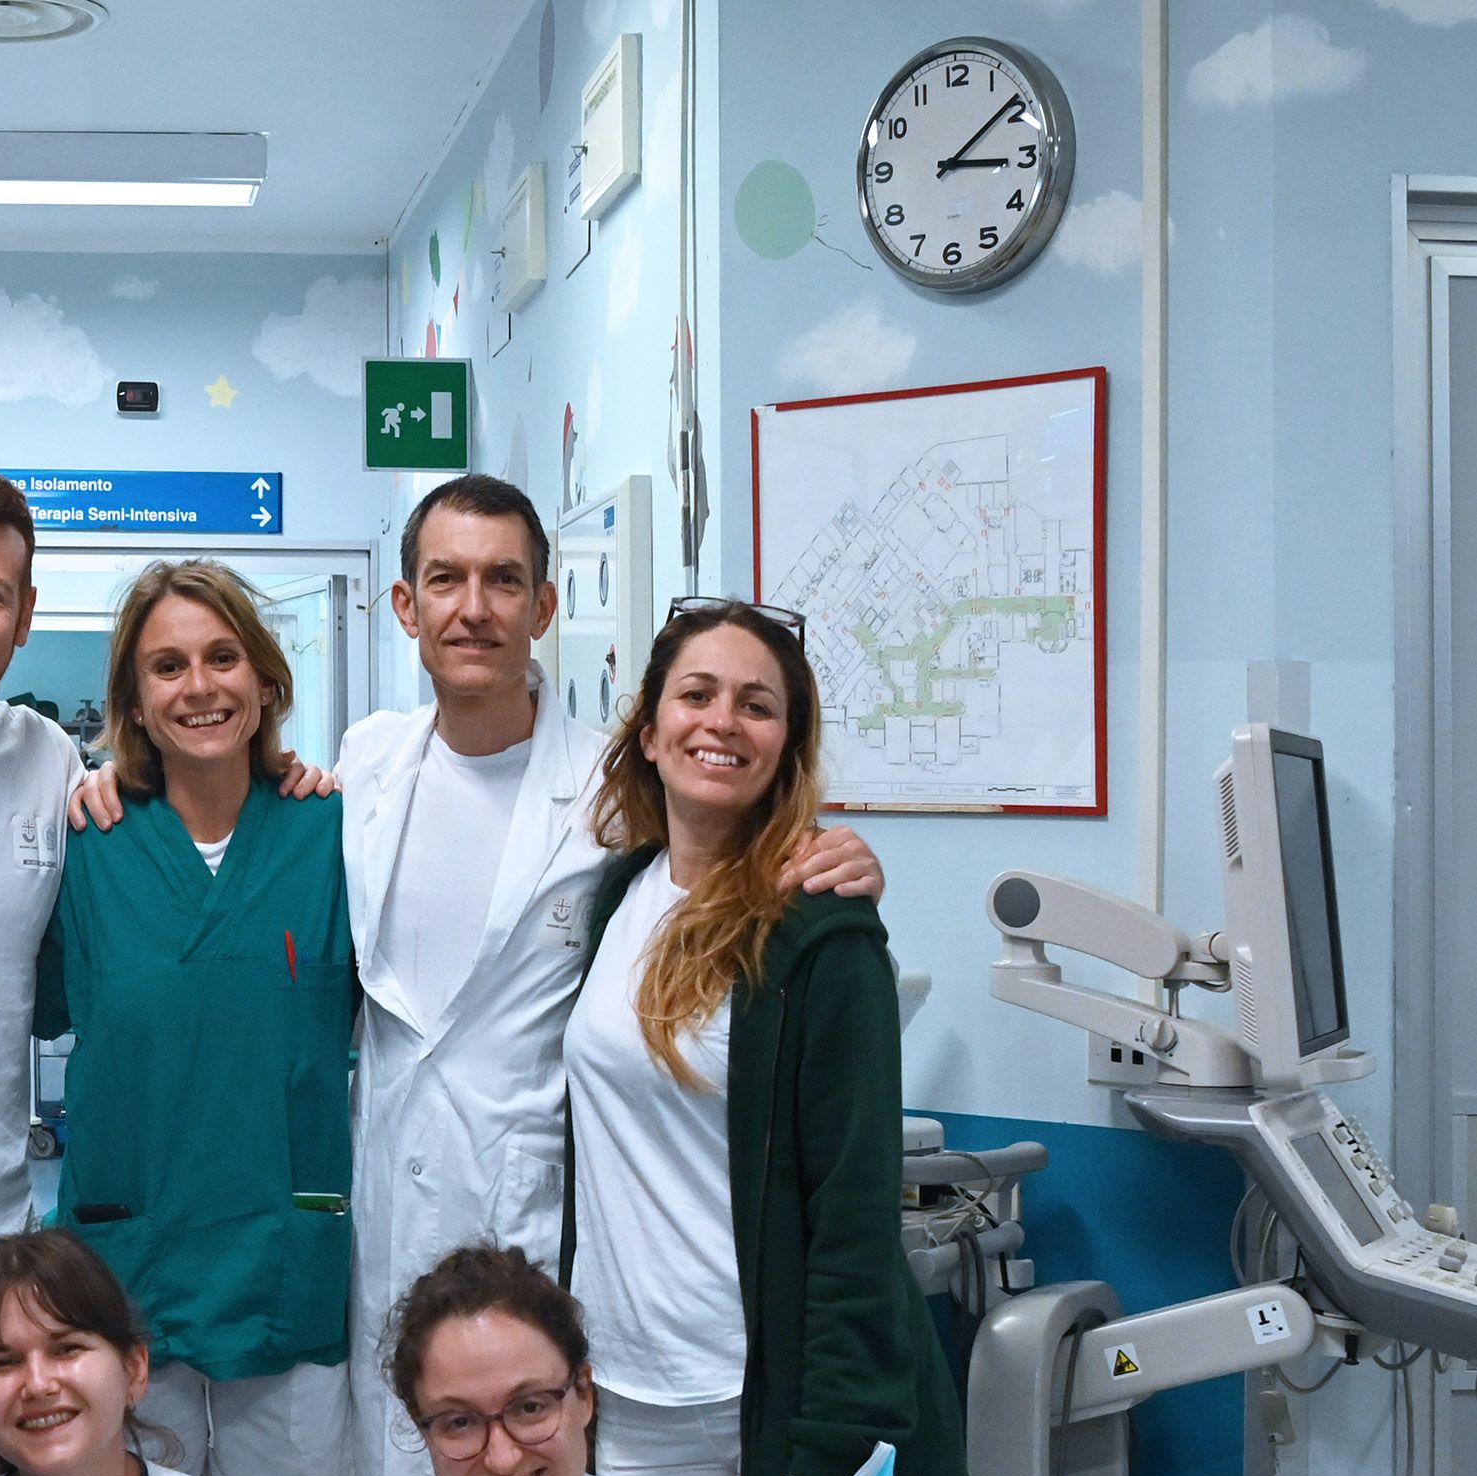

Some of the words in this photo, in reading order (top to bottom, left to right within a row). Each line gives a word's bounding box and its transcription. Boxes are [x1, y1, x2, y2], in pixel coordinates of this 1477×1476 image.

[946, 64, 969, 88] 12
[989, 70, 995, 92] 1
[914, 84, 927, 107] 11
[889, 117, 907, 140] 10
[1017, 144, 1037, 169] 3
[874, 161, 894, 184] 9
[1006, 189, 1024, 212] 4
[884, 204, 905, 226] 8
[909, 234, 926, 257] 7
[978, 226, 999, 249] 5
[942, 242, 962, 266] 6
[30, 476, 113, 491] Isolamento
[29, 506, 84, 524] Terapia
[87, 507, 198, 523] Semi-Intensiva
